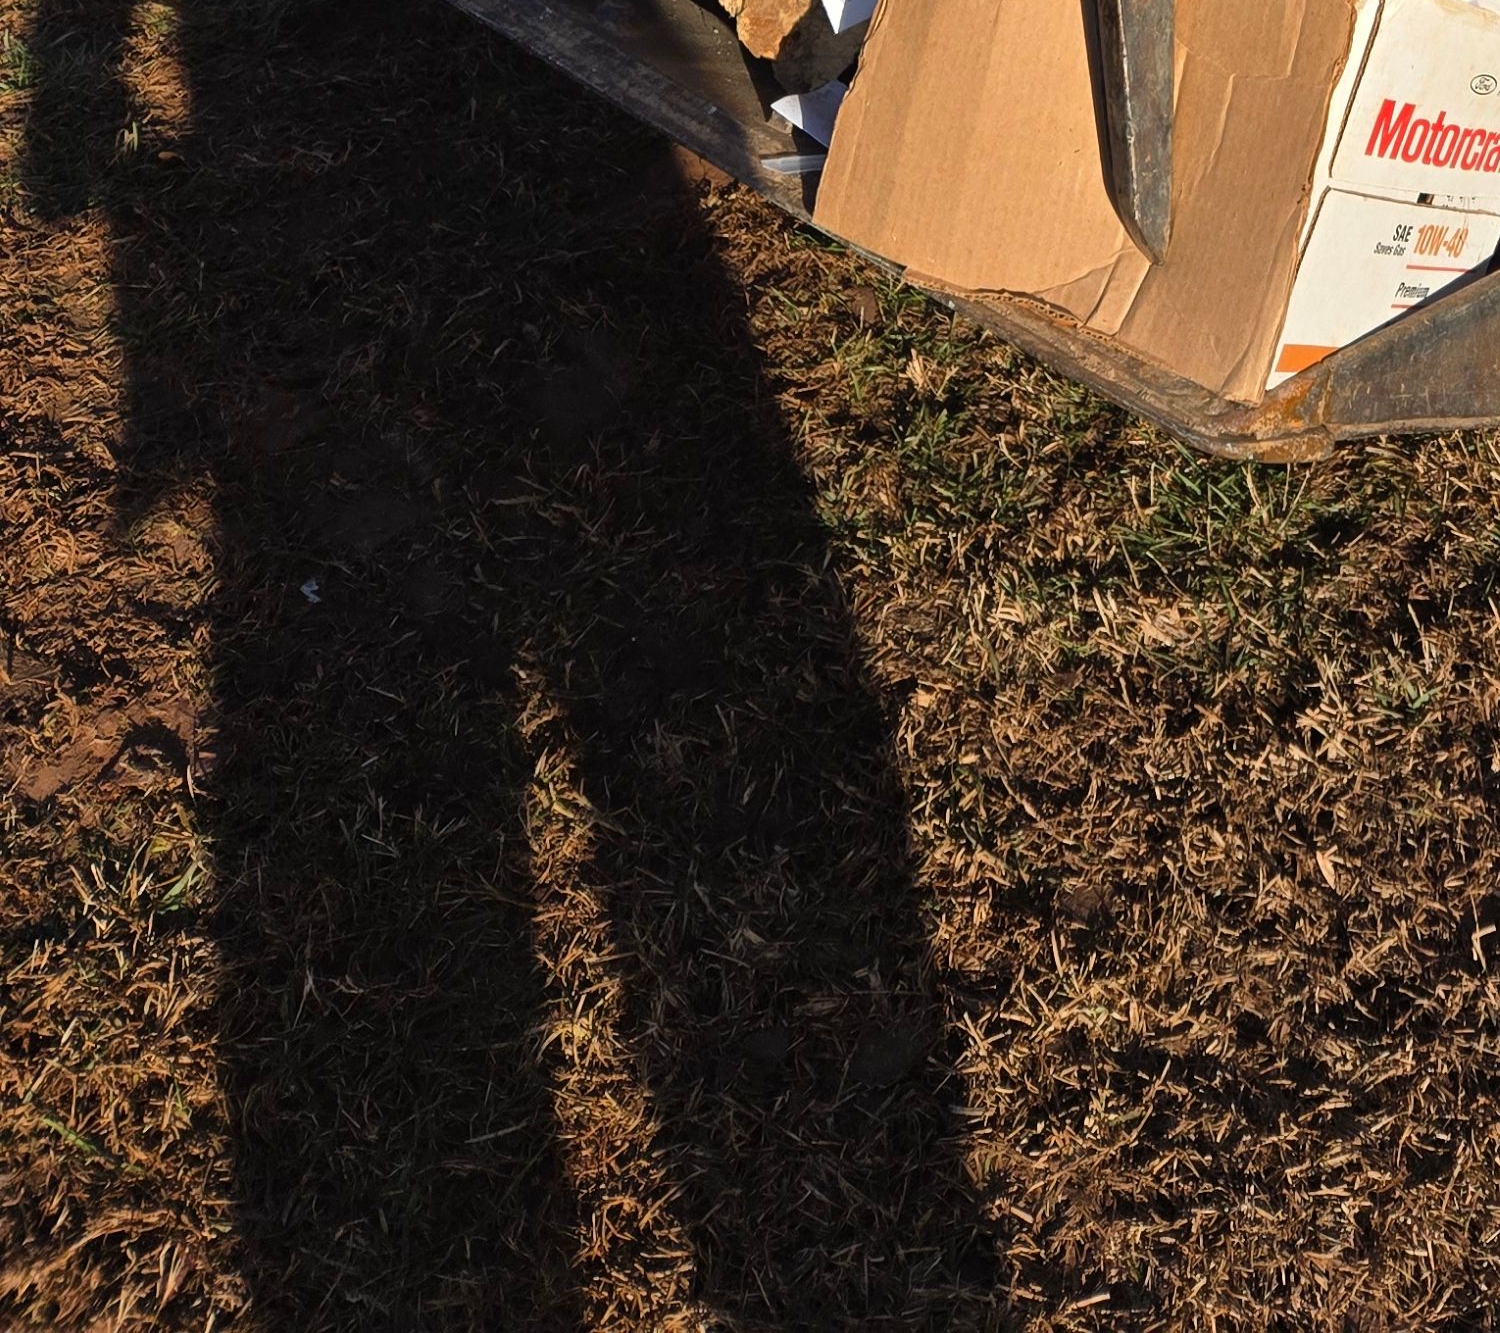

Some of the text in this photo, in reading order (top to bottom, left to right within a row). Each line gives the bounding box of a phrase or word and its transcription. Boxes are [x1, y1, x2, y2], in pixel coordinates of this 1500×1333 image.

[1392, 223, 1469, 258] SAE 10W-40
[1393, 245, 1406, 257] Gas
[1395, 281, 1430, 299] Premium
